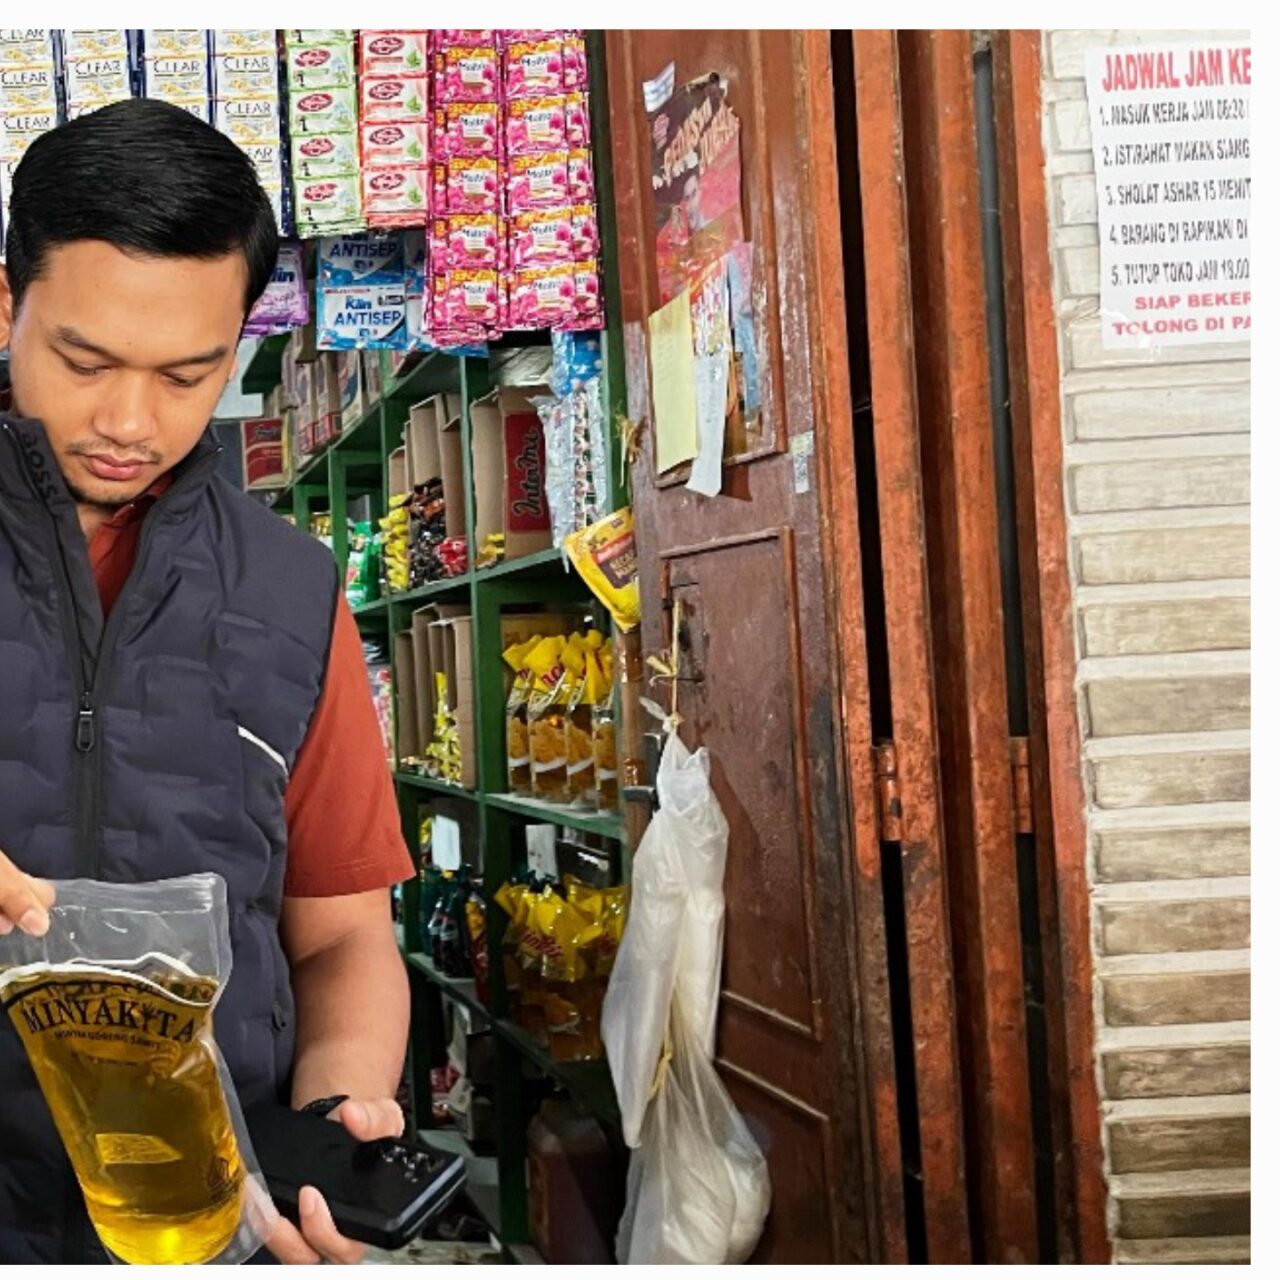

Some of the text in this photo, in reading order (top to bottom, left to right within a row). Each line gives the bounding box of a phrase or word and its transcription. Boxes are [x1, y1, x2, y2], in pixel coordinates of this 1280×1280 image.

[76, 61, 120, 74] CLEAR
[154, 61, 200, 74] CLEAR
[223, 58, 269, 70] CLEAR
[1102, 48, 1251, 92] JADWAL JAM KE
[1, 73, 48, 85] CLEAR
[225, 102, 270, 114] CLEAR
[1099, 105, 1109, 126] 1.
[1111, 103, 1150, 126] MASUK
[1152, 101, 1189, 123] KERJA
[1192, 99, 1214, 122] JAM
[4, 118, 50, 130] CLEAR
[1102, 138, 1250, 166] 2. ISTIRAHAT MAKAN SIANG
[1117, 183, 1160, 205] SHOLAT
[1163, 181, 1200, 203] ASHAR
[1203, 179, 1216, 201] 15
[1121, 222, 1166, 245] BARANG
[1168, 222, 1179, 243] DI
[1237, 218, 1248, 240] DI
[330, 242, 398, 258] ANTISEP
[1111, 265, 1122, 286] 5.
[1125, 263, 1160, 285] TUTUP
[1162, 261, 1193, 283] TOKO
[1196, 259, 1218, 281] JAM
[1135, 295, 1181, 310] SIAP
[334, 311, 401, 326] ANTISEP
[1112, 318, 1198, 336] TOLONG
[1205, 317, 1224, 331] DI
